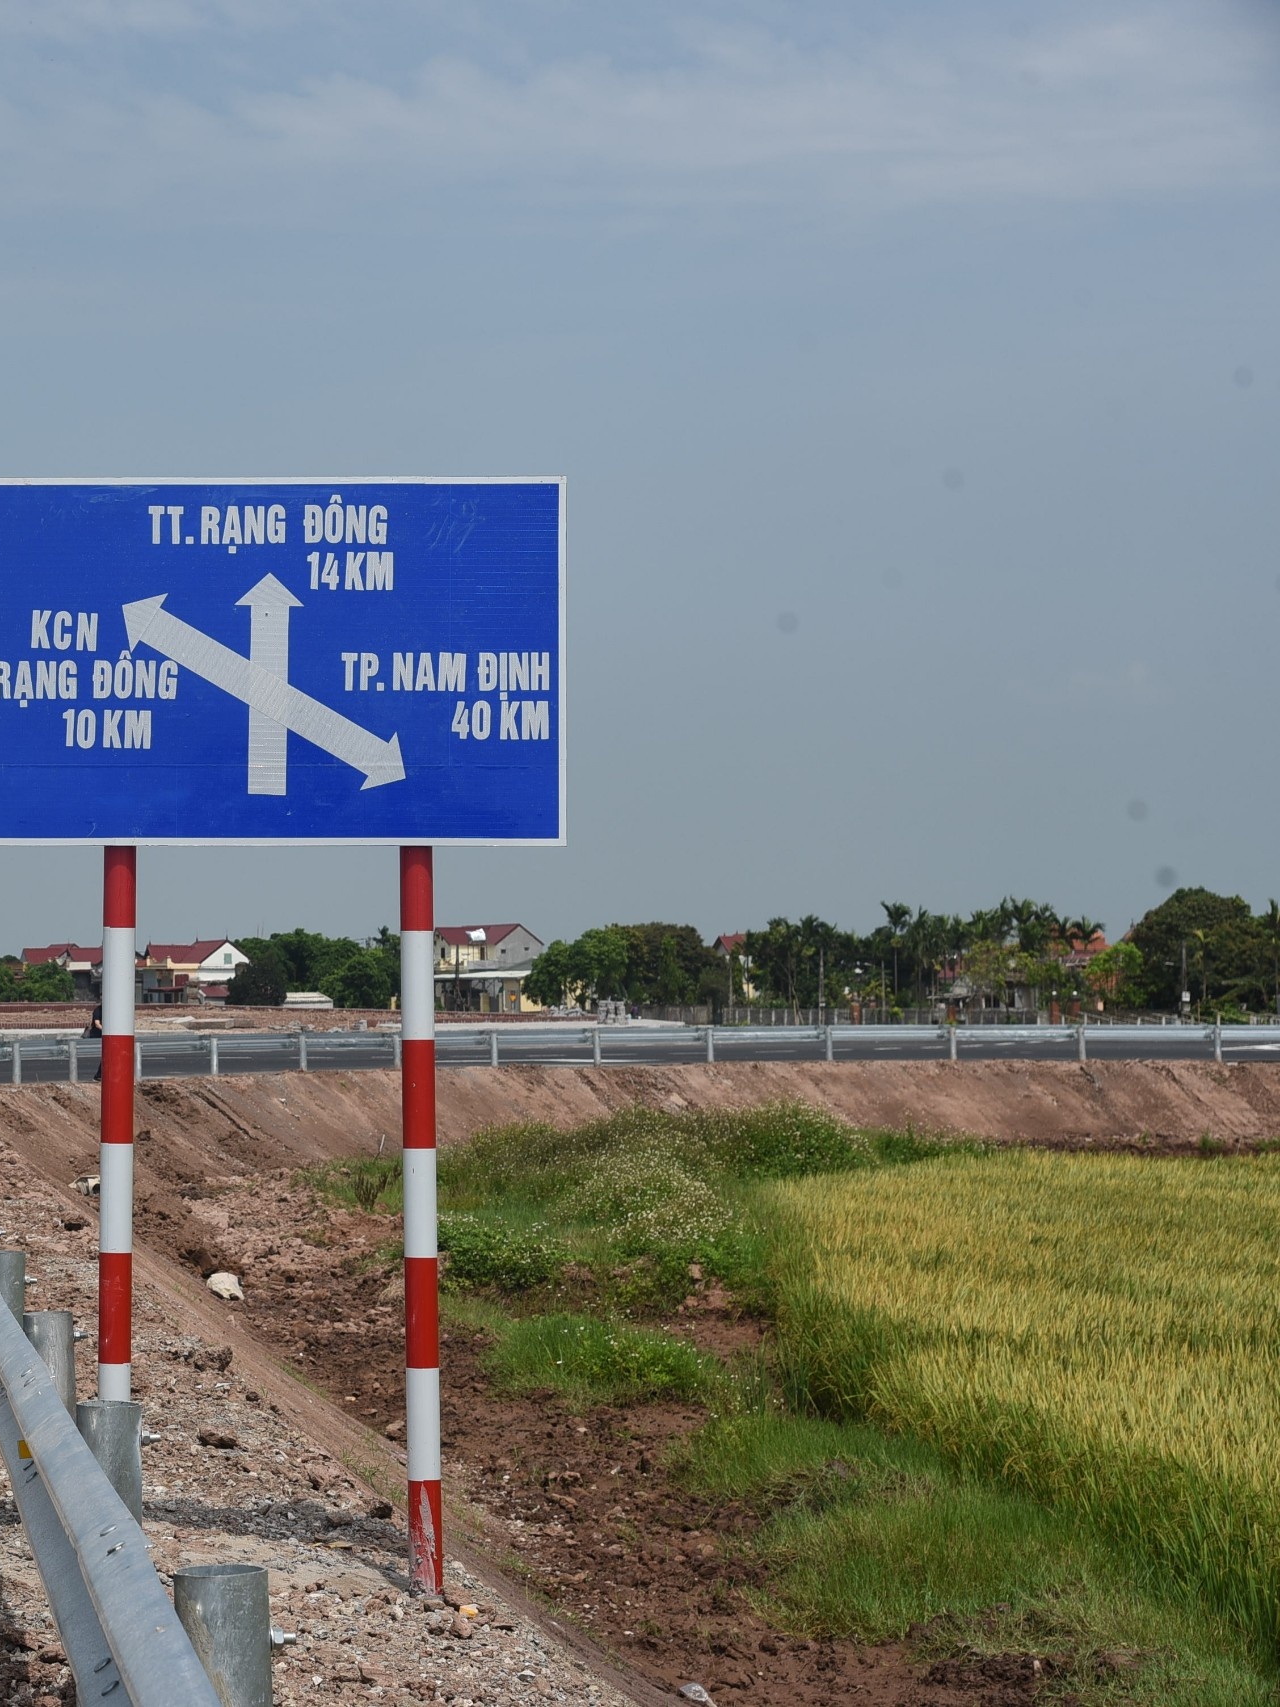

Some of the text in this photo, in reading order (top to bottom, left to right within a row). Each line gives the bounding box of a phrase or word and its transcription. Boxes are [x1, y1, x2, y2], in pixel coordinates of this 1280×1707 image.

[303, 494, 388, 545] ĐÔNG
[306, 551, 394, 591] 14 KM
[30, 609, 99, 652] KCN
[92, 650, 179, 700] ĐÔNG
[477, 652, 550, 701] ĐỊNH
[62, 708, 152, 750] 10 KM
[451, 700, 550, 740] 40 KM
